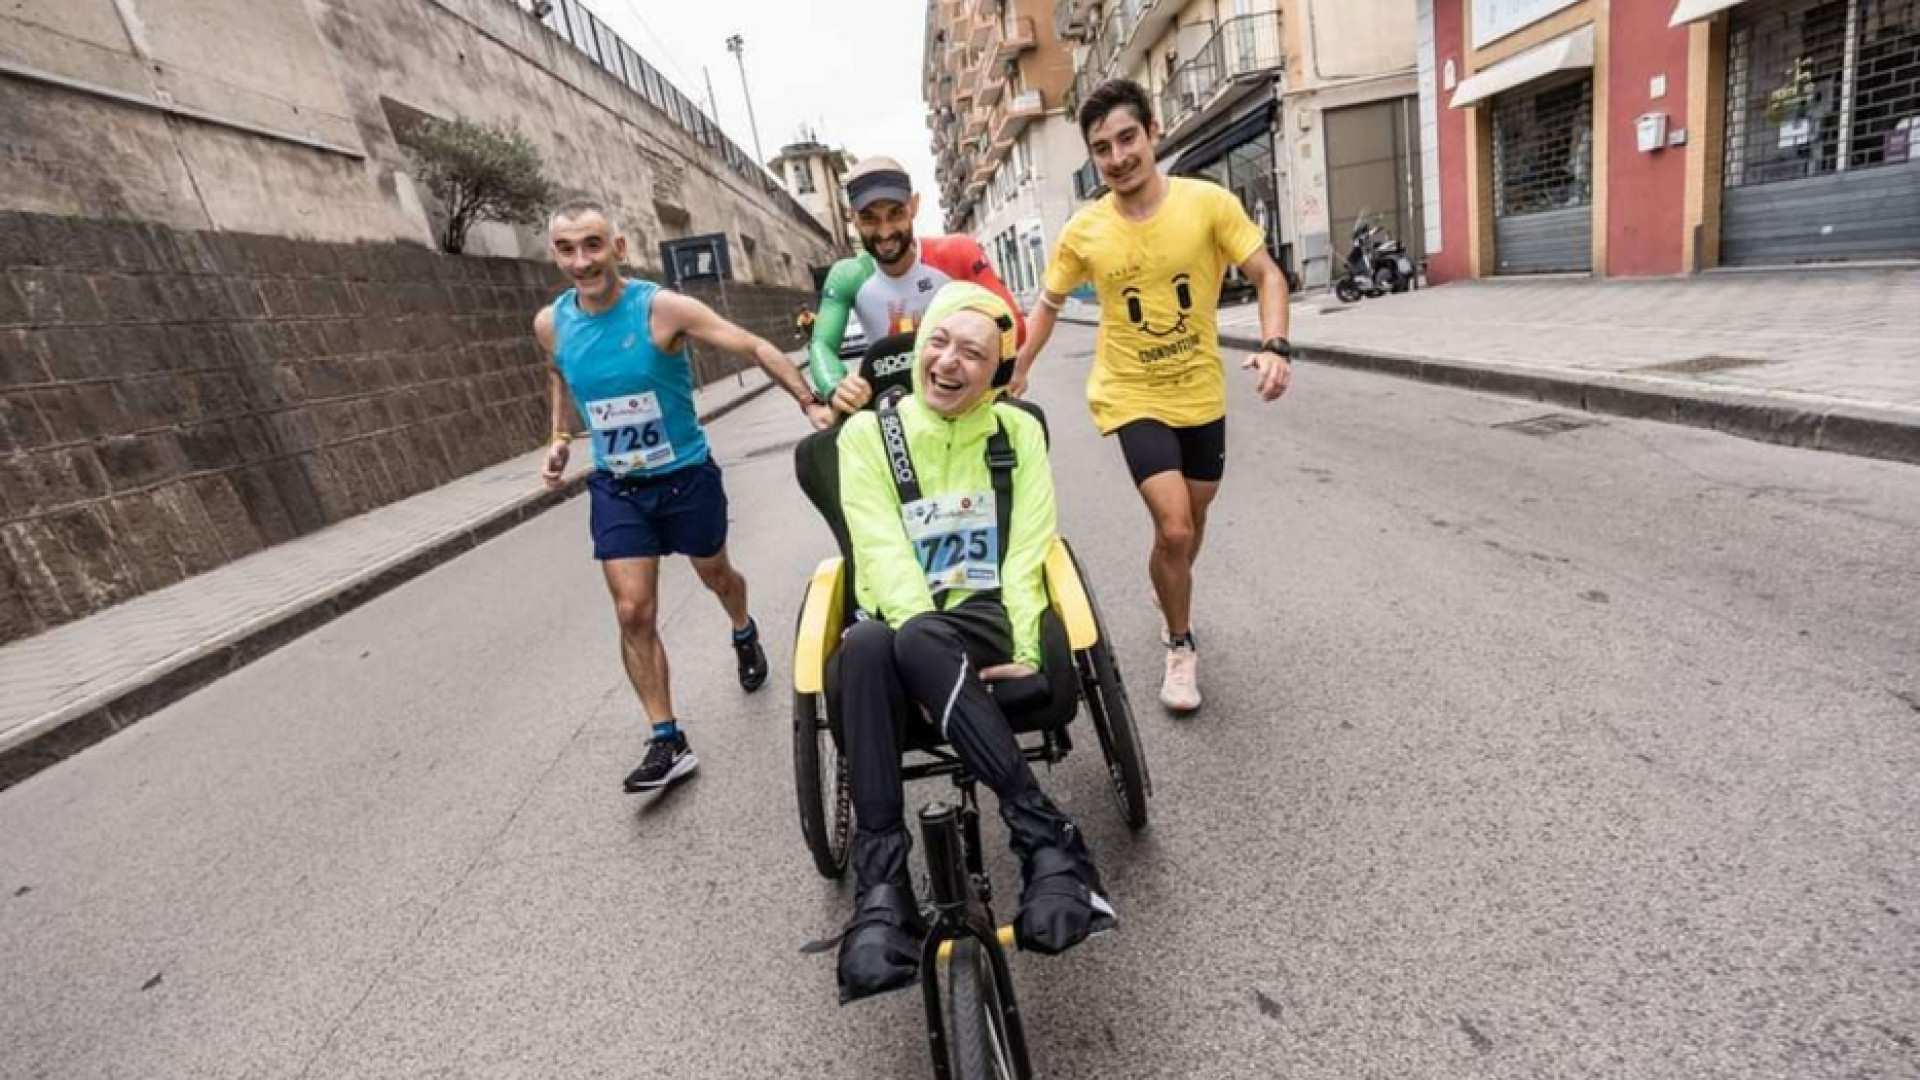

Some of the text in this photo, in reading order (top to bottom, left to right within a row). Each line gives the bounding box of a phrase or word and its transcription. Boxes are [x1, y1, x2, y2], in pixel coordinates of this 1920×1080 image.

[873, 352, 915, 377] spar
[602, 421, 659, 455] 726
[920, 529, 988, 574] 725
